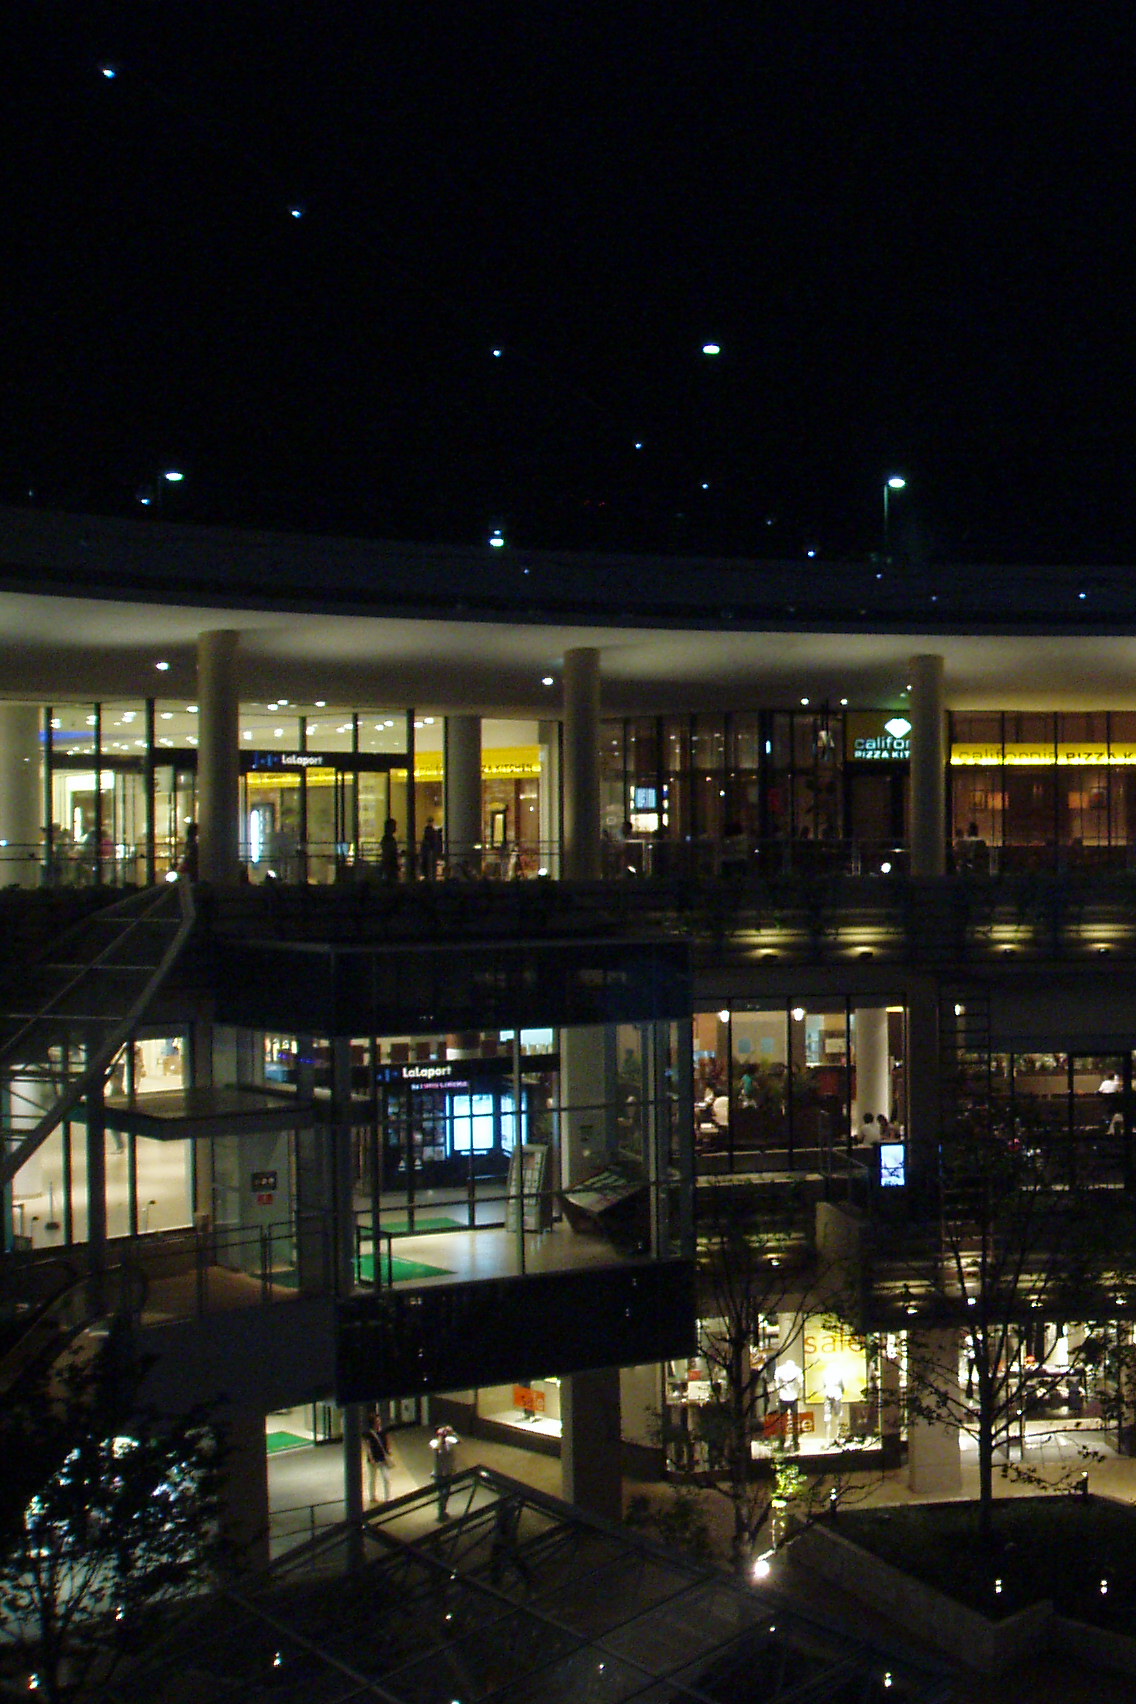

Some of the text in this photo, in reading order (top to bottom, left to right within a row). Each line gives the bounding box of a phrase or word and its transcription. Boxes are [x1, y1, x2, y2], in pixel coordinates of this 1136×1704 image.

[854, 736, 911, 750] califor
[281, 753, 323, 767] LaLaport
[402, 1065, 452, 1080] LaLaport
